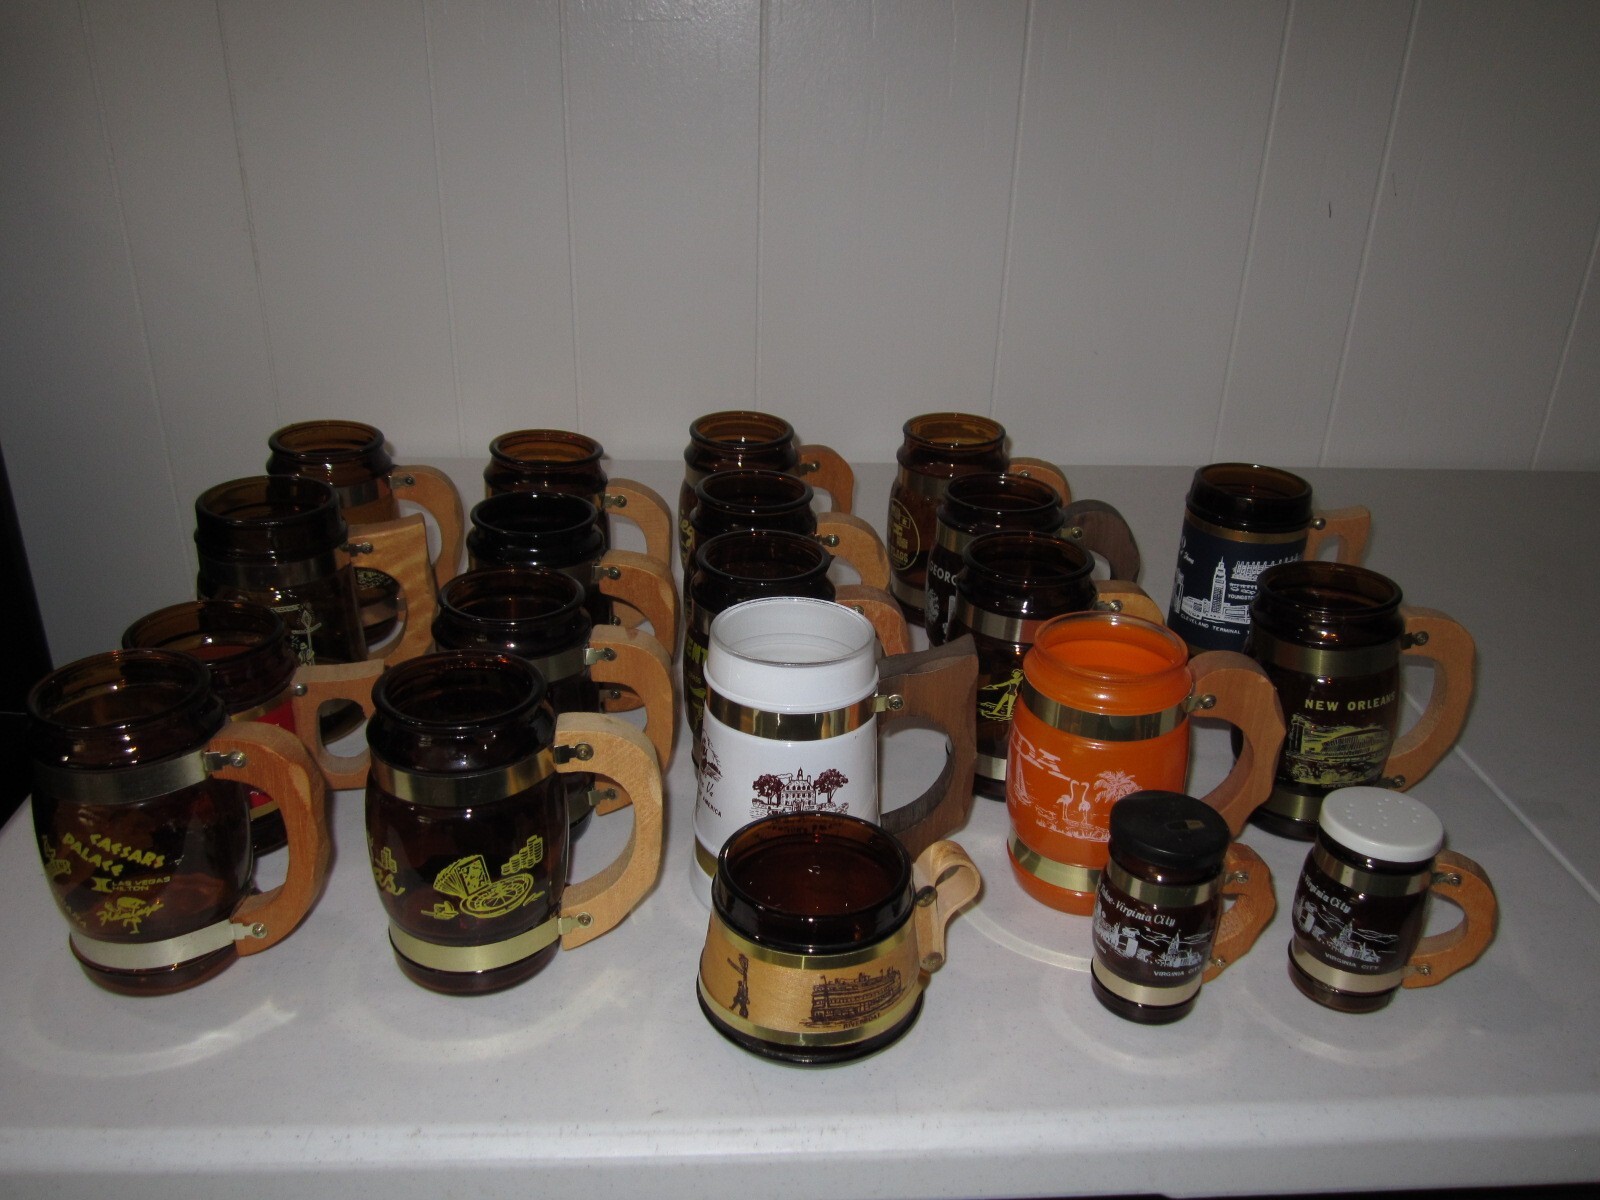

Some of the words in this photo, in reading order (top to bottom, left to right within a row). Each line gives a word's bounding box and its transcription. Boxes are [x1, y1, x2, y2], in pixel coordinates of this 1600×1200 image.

[1180, 613, 1209, 629] CLEVELAND
[1212, 625, 1241, 635] TERMINAL
[1304, 698, 1339, 712] NEW
[1347, 690, 1396, 711] ORLEANS
[61, 831, 126, 877] PALACE
[89, 832, 166, 869] CAESARS
[134, 875, 171, 886] VEGAS
[1114, 900, 1152, 923] Virginia
[1153, 914, 1176, 928] City
[1330, 896, 1352, 914] City
[1324, 951, 1357, 968] VIRGINIA
